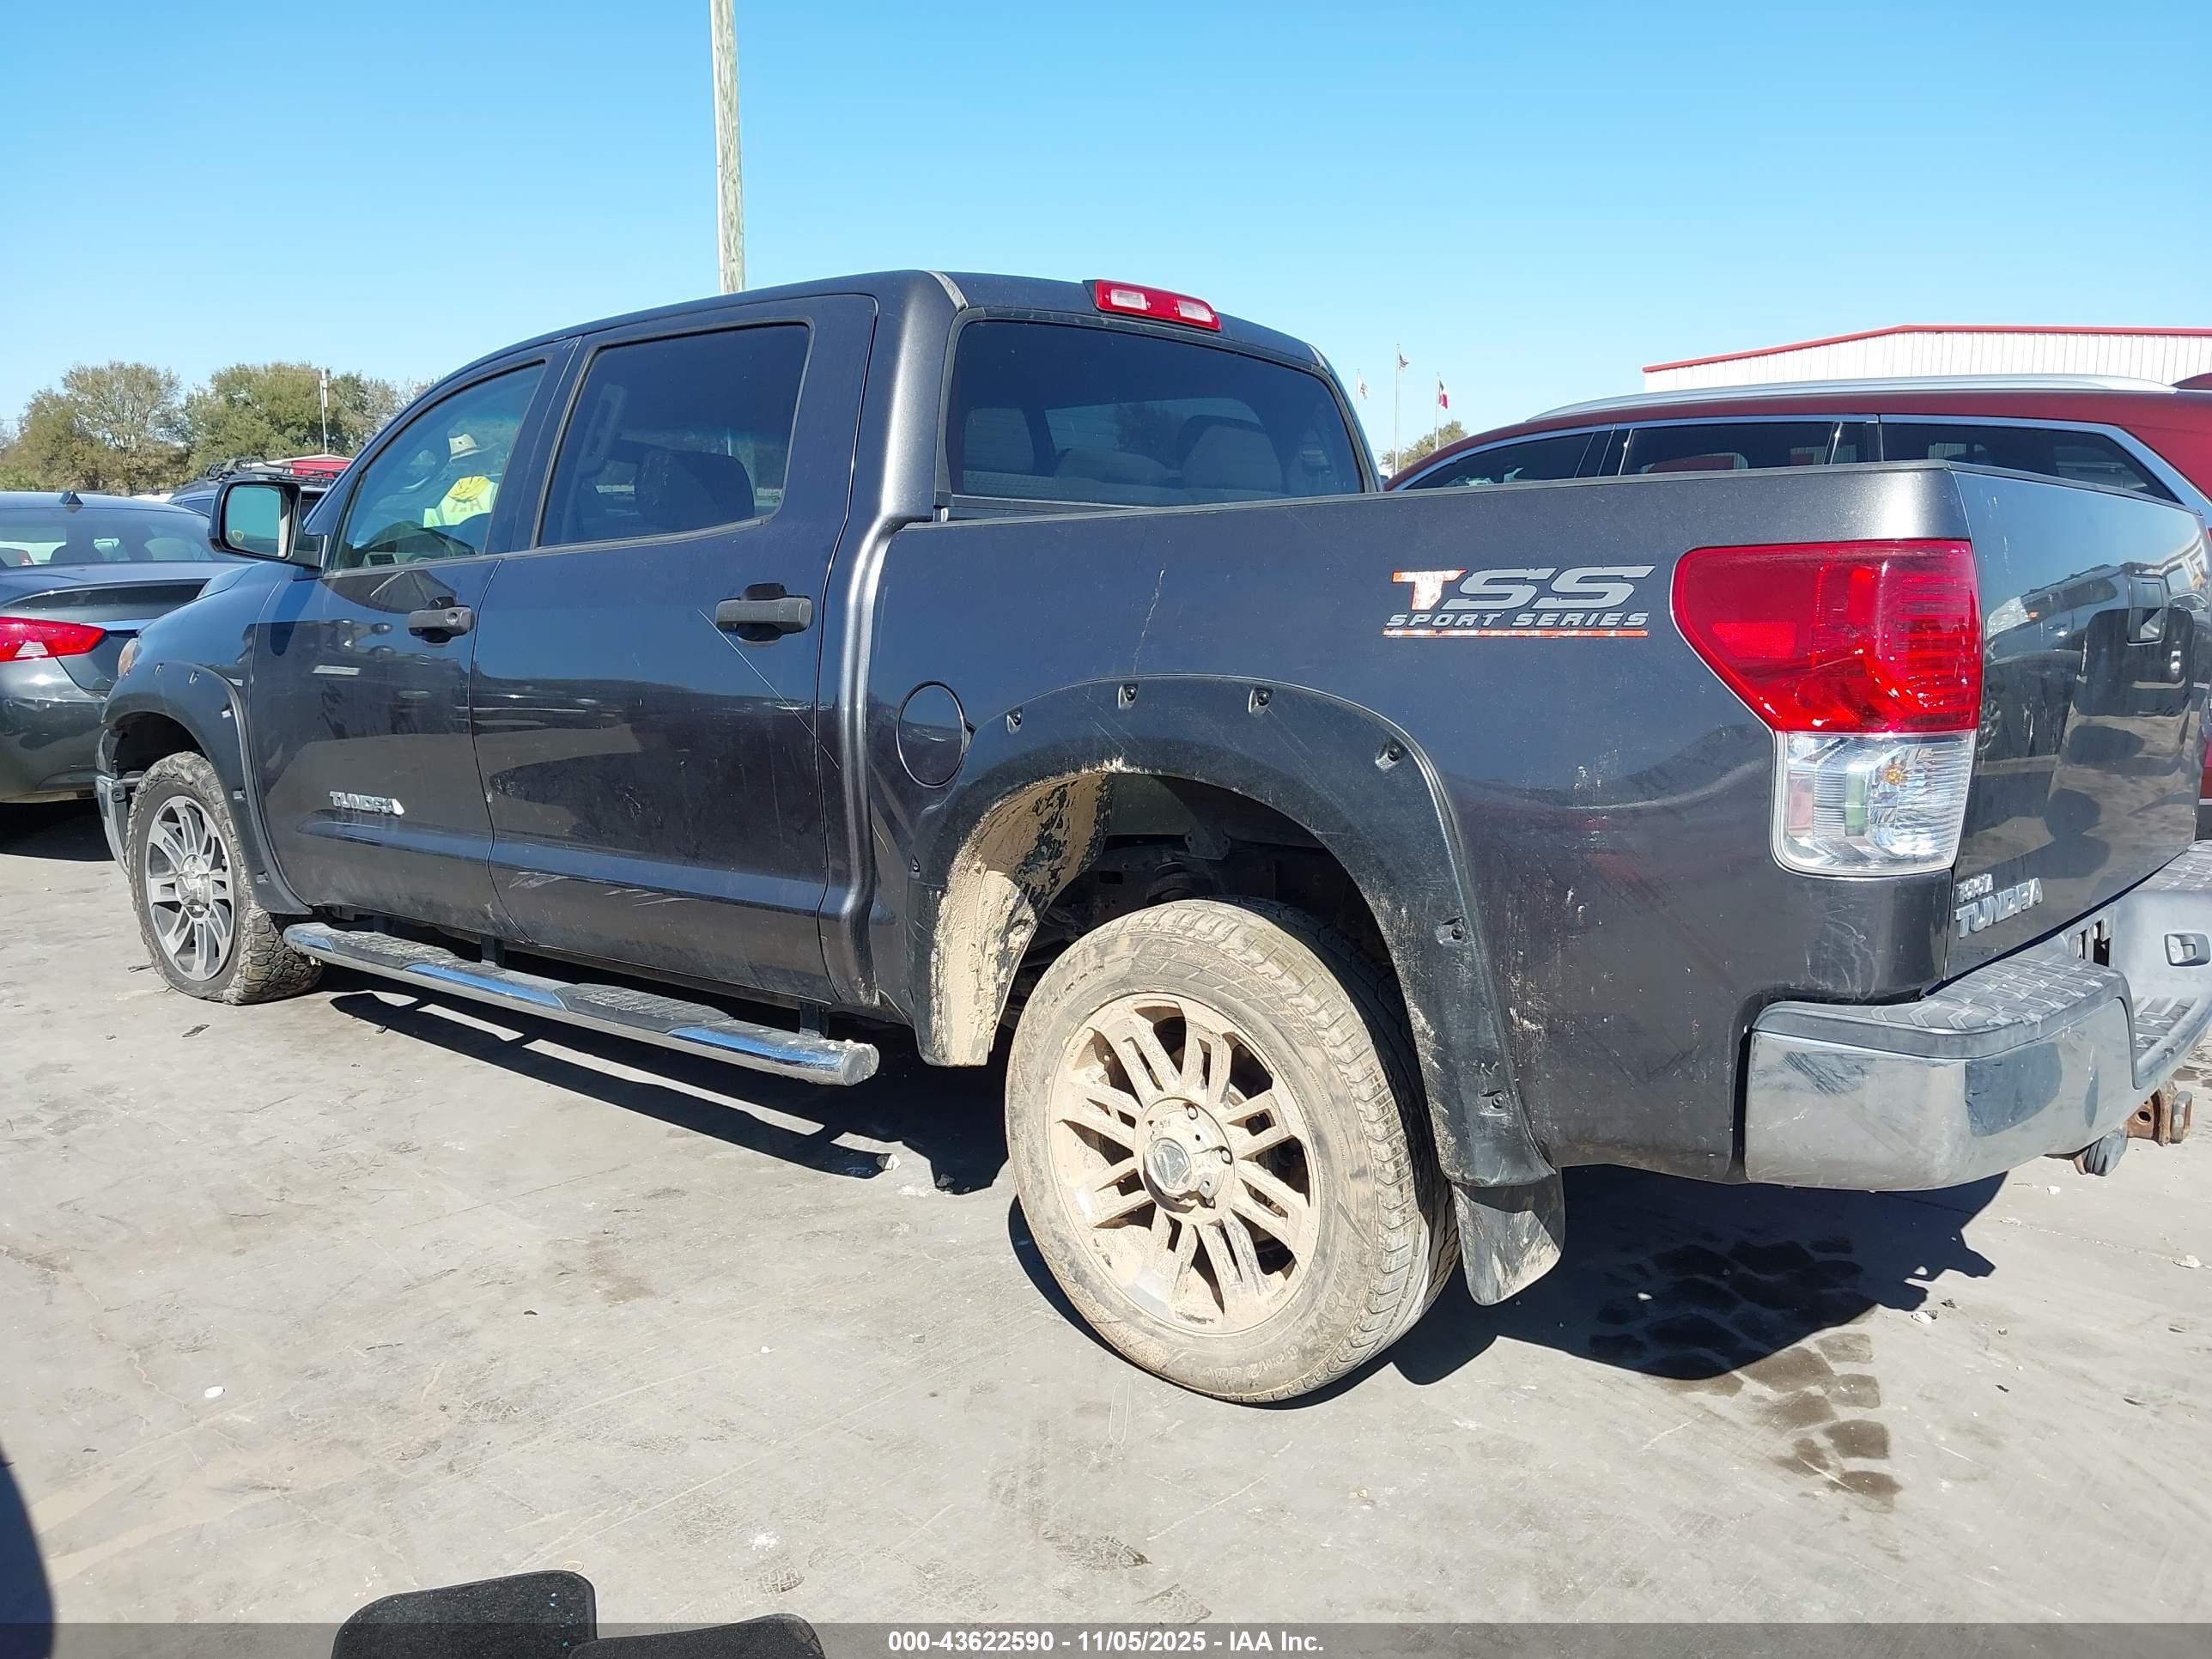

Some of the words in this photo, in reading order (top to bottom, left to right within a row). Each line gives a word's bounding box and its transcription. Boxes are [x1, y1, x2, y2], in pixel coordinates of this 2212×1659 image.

[1391, 565, 1656, 611] TSS
[1386, 612, 1504, 628] SPORT
[1511, 612, 1649, 628] SERIES
[329, 791, 404, 816] TUNDRA
[1954, 877, 2044, 938] TUNDRA
